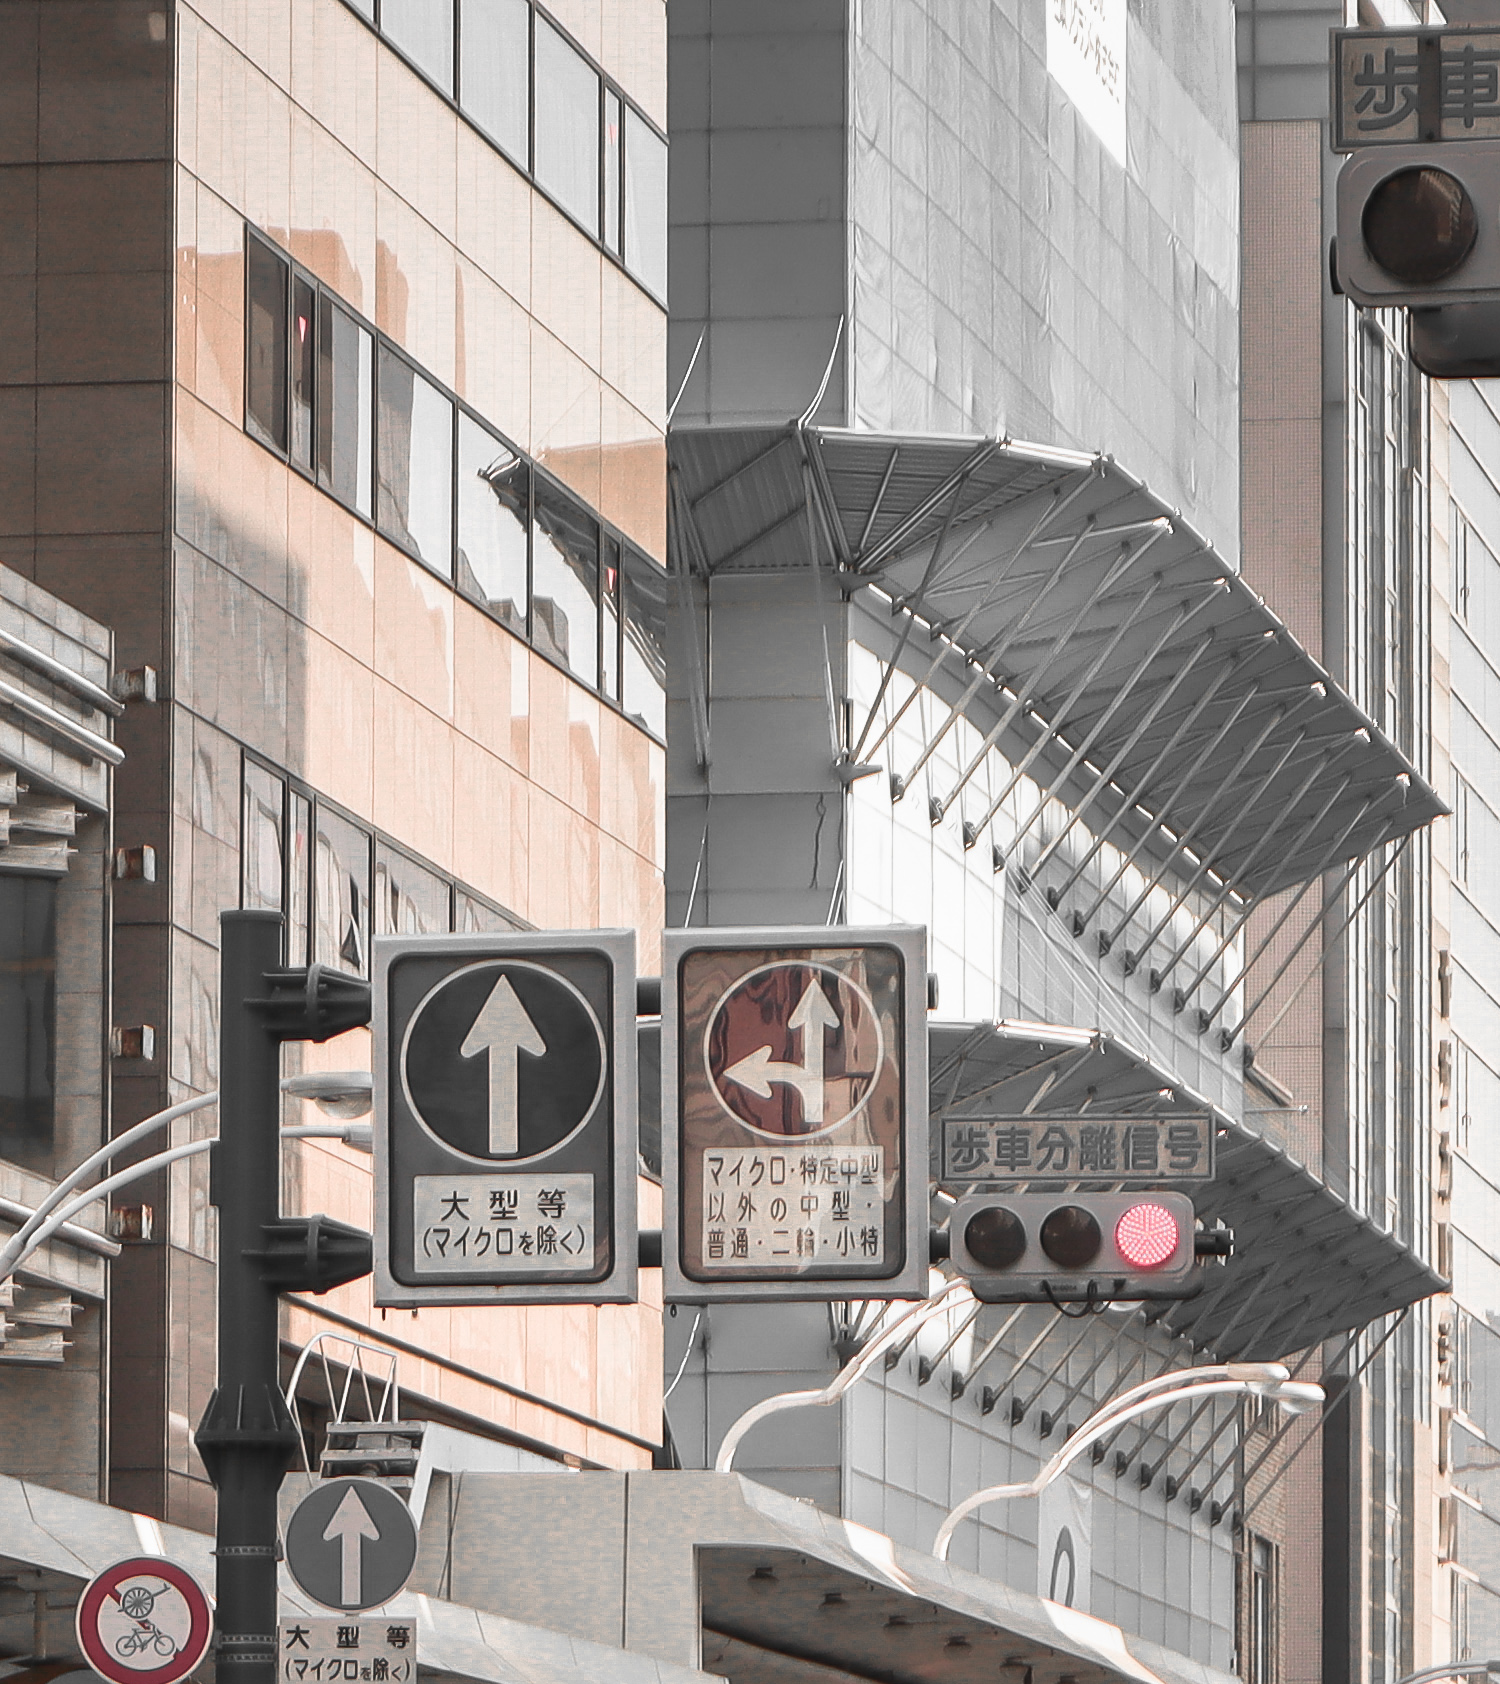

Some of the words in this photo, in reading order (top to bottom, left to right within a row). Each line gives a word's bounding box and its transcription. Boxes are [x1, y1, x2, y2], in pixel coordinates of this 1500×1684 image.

[949, 1122, 1203, 1174] 歩車分離信号
[440, 1188, 568, 1222] 大型等
[285, 1624, 411, 1649] 大型等
